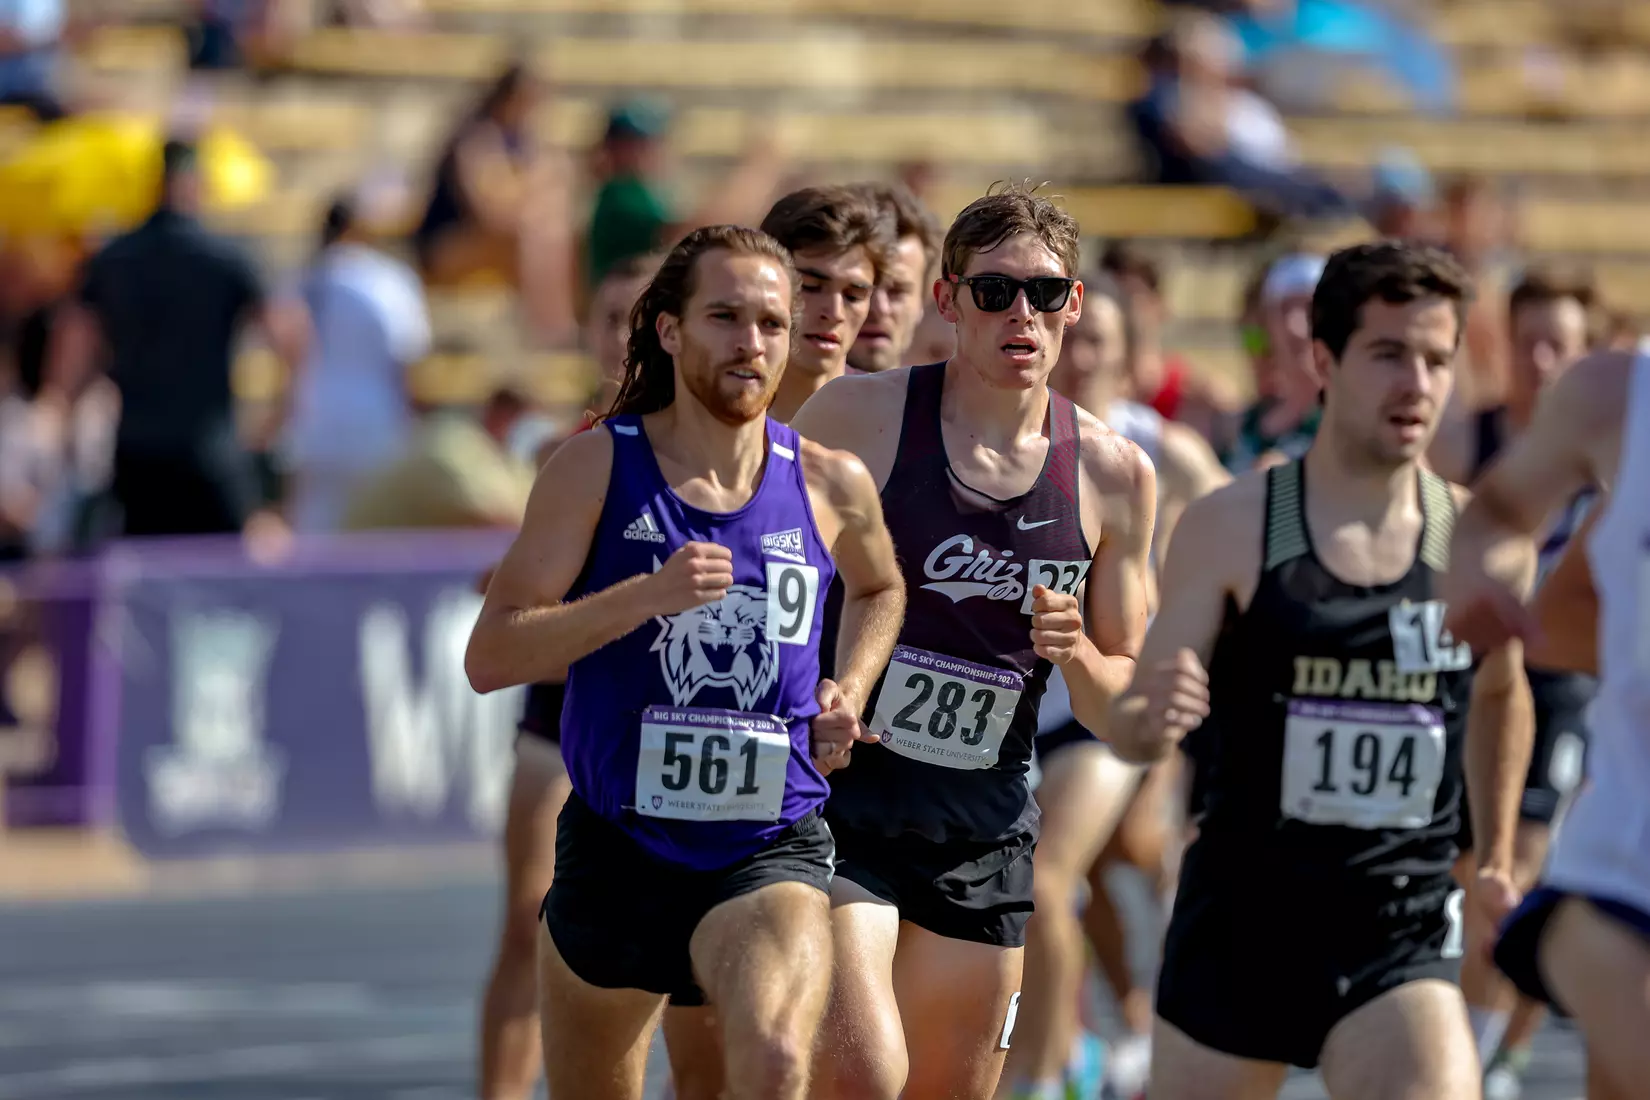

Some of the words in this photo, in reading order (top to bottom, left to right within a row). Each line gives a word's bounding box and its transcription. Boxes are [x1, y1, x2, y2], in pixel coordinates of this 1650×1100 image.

[623, 529, 666, 543] adidas
[923, 533, 1025, 601] Griz
[778, 567, 808, 638] 9
[903, 649, 918, 661] BIG
[919, 654, 935, 667] SKY
[935, 657, 998, 681] CHAMPIONSHIPS
[998, 674, 1015, 686] 2021
[653, 711, 669, 721] BIG
[671, 712, 686, 722] SKY
[756, 720, 775, 730] 2021
[891, 672, 997, 747] 283
[661, 731, 760, 796] 561
[896, 737, 922, 751] WEBER
[923, 744, 945, 756] STATE
[946, 749, 987, 763] UNIVERSITY
[1312, 727, 1417, 797] 194
[667, 799, 695, 810] WEBER
[697, 803, 720, 812] STATE
